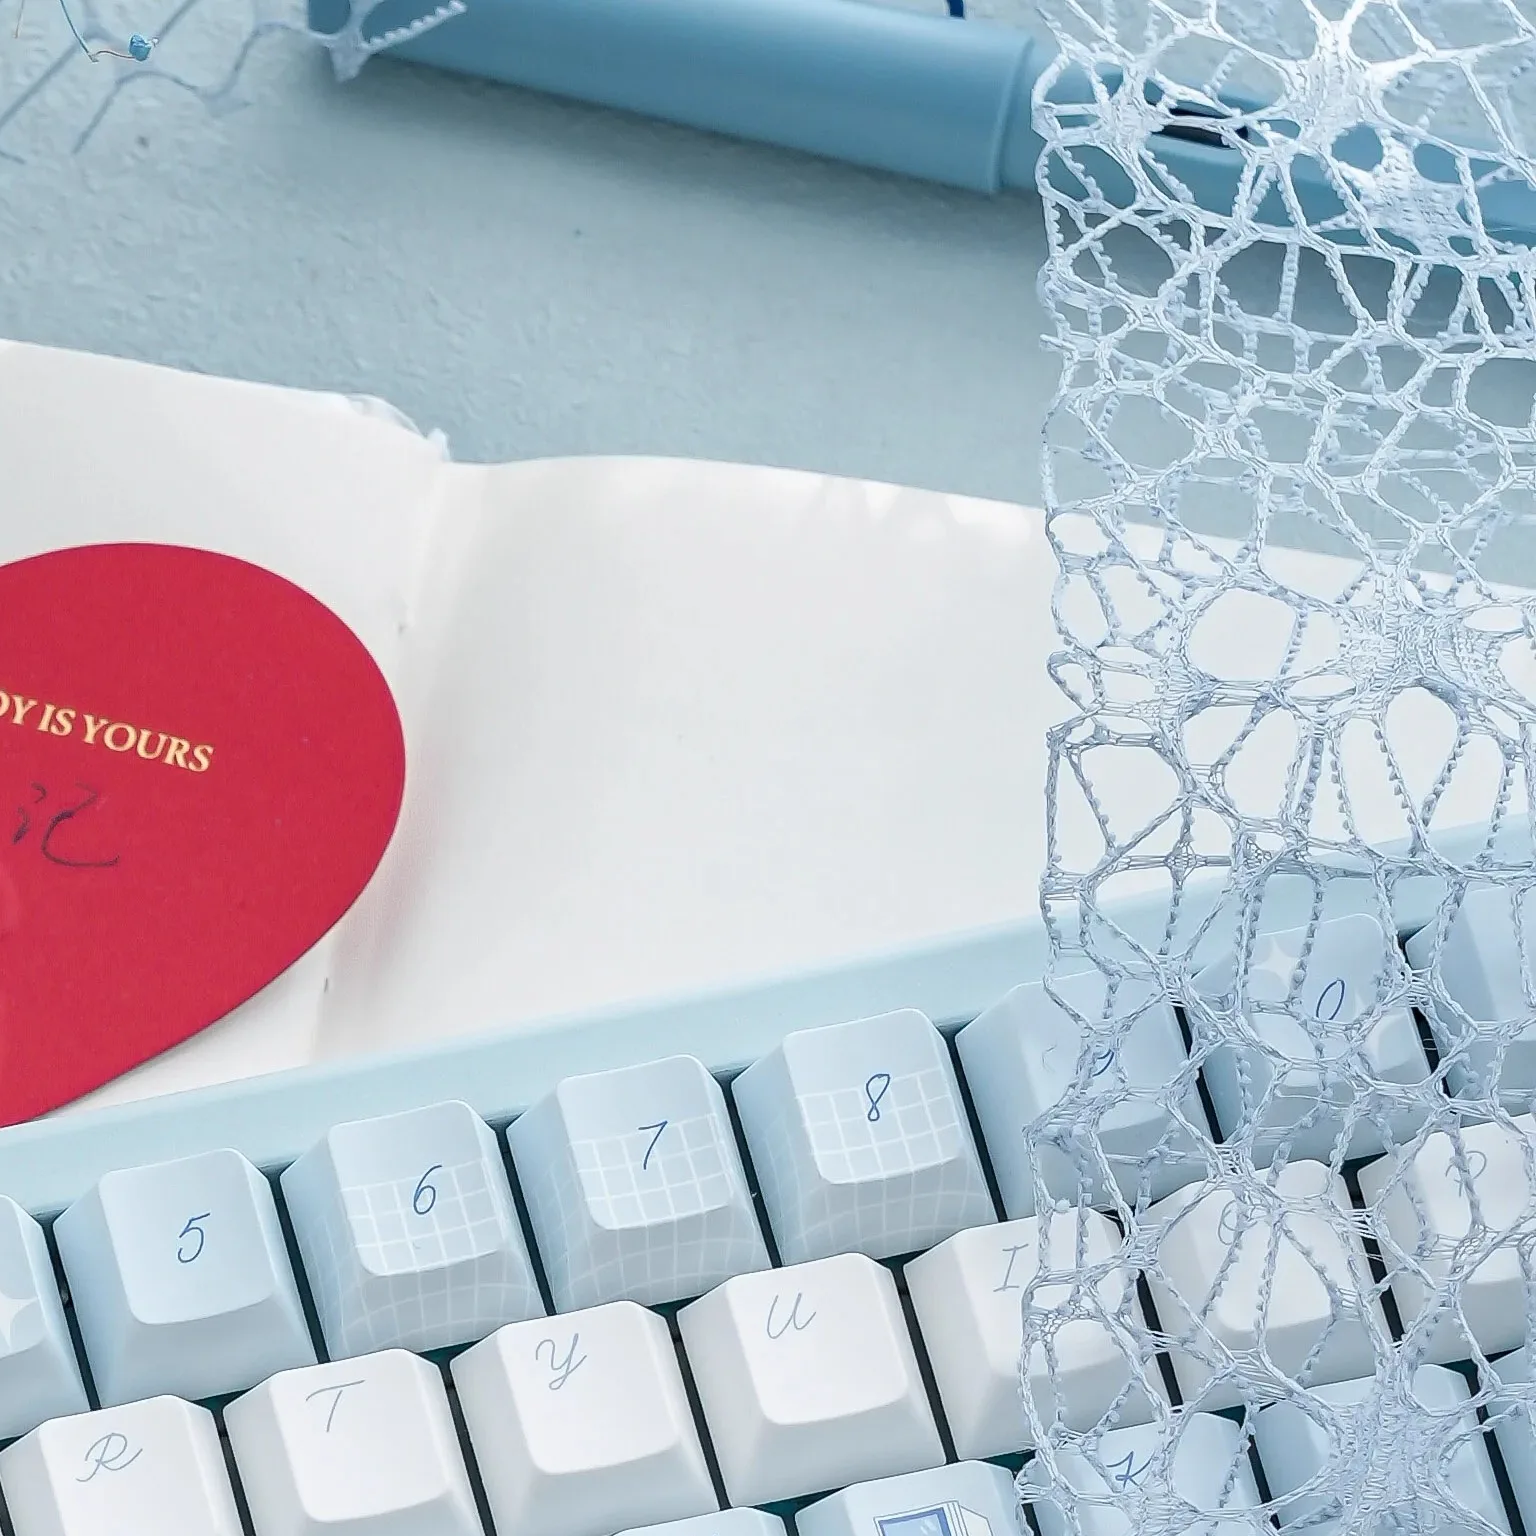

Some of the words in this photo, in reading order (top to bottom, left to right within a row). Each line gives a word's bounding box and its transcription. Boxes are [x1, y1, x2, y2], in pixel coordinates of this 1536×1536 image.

[37, 703, 77, 737] IS
[82, 713, 215, 773] YOURS
[864, 1072, 892, 1123] 8
[637, 1119, 670, 1171] 7
[412, 1164, 444, 1216] 6
[176, 1211, 212, 1264] 5
[304, 1379, 366, 1434] T
[75, 1432, 145, 1483] R
